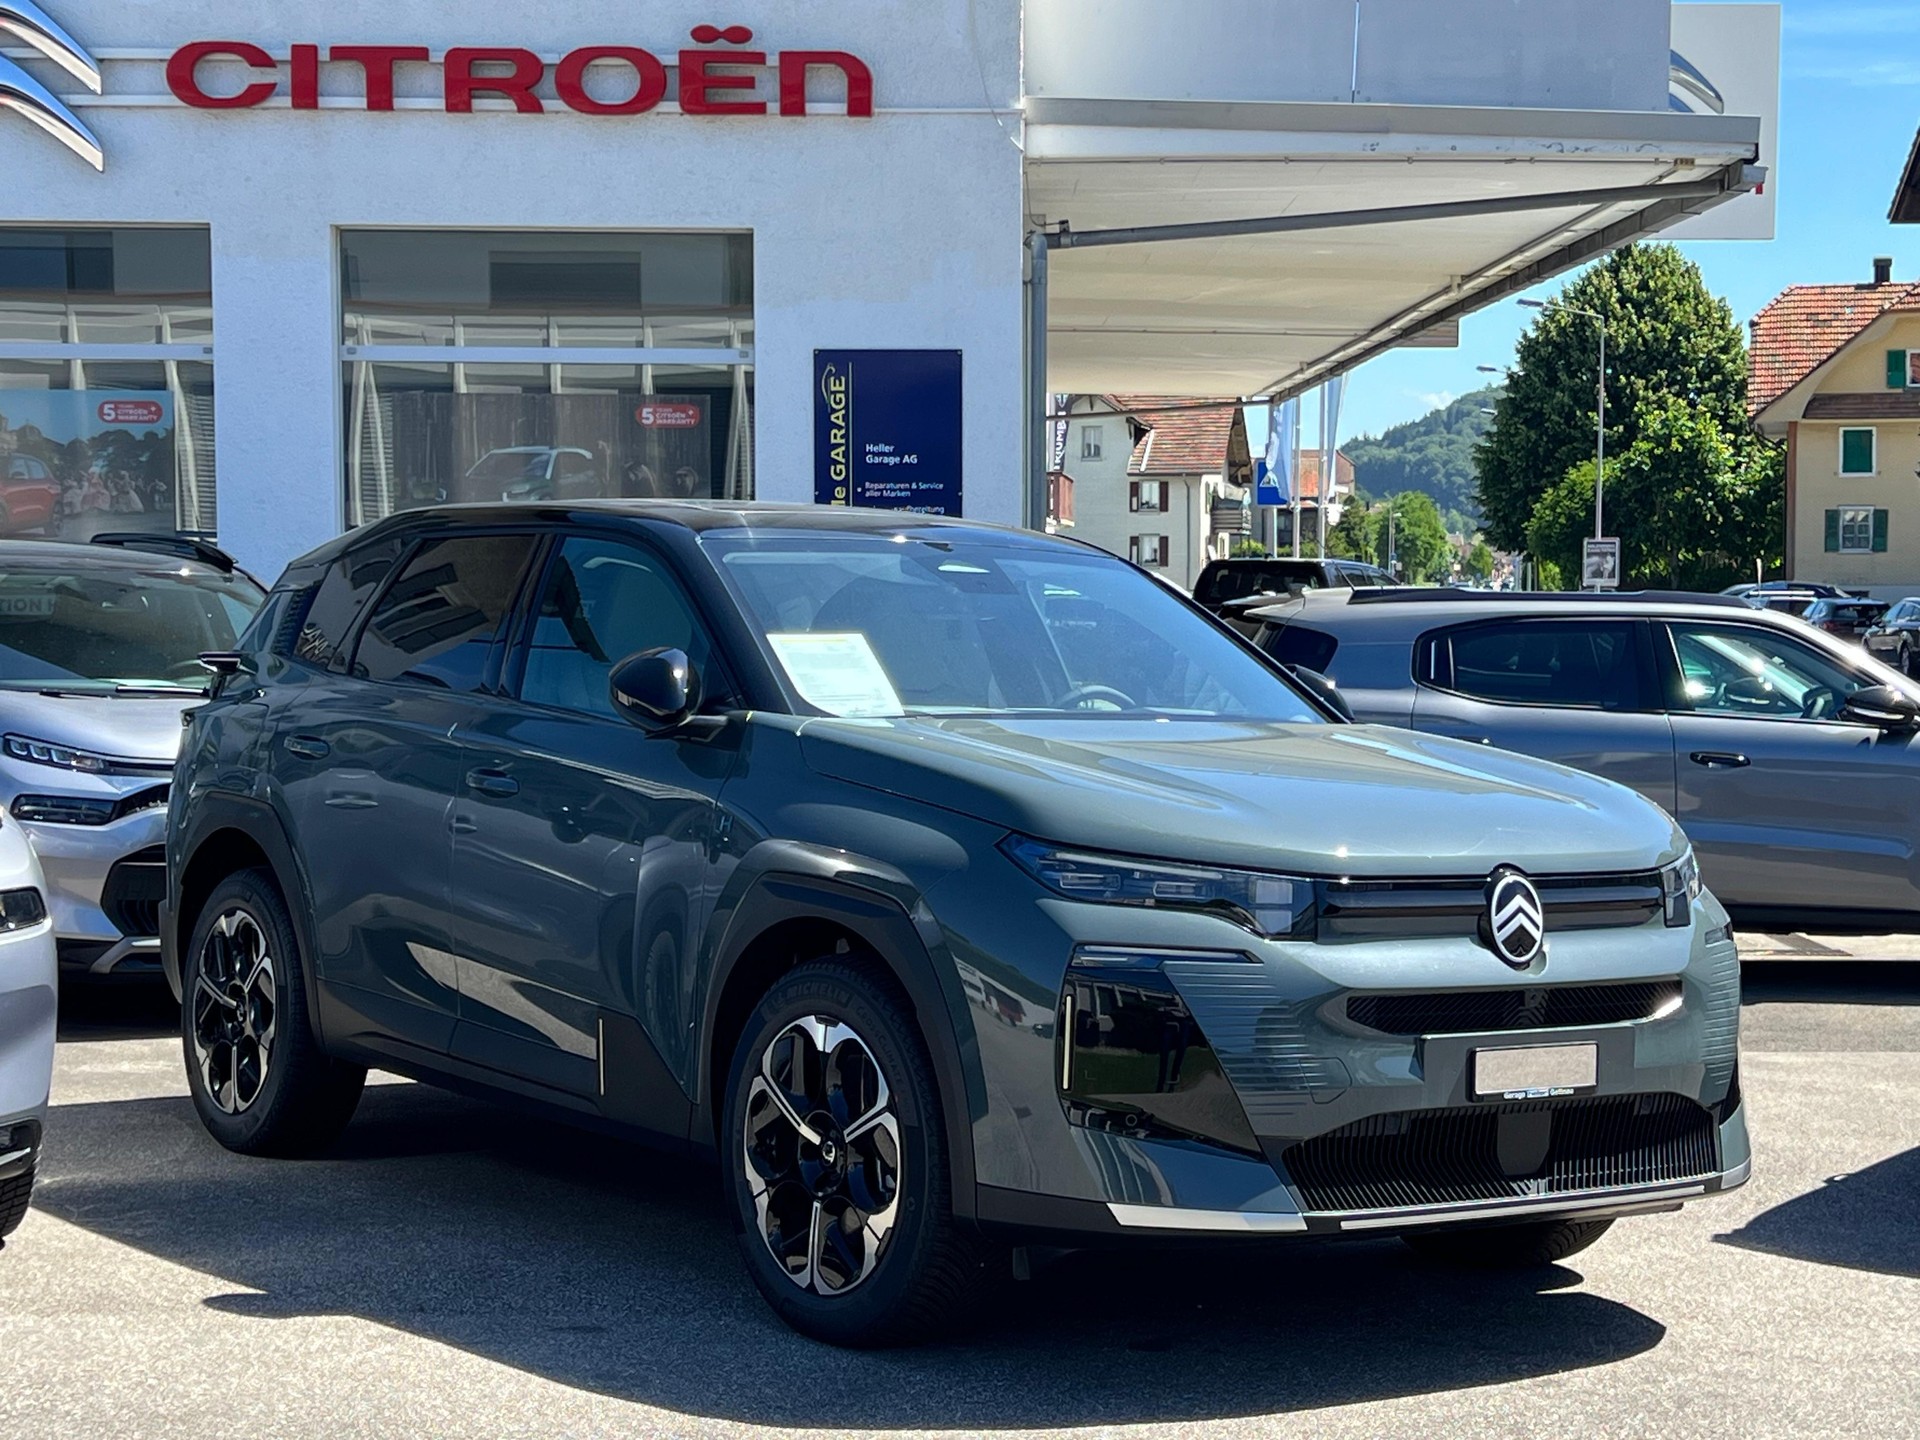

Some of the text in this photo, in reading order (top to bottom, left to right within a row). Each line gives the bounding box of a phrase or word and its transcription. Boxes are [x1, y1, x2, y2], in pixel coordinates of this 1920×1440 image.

[166, 25, 873, 117] CITROËN
[103, 403, 116, 421] 5
[641, 407, 655, 425] 5
[830, 375, 846, 481] GARAGE
[865, 443, 895, 453] Heller
[865, 454, 918, 466] Garage AG
[865, 482, 944, 491] Reparaturen & Service
[785, 982, 851, 1007] MICHELIN
